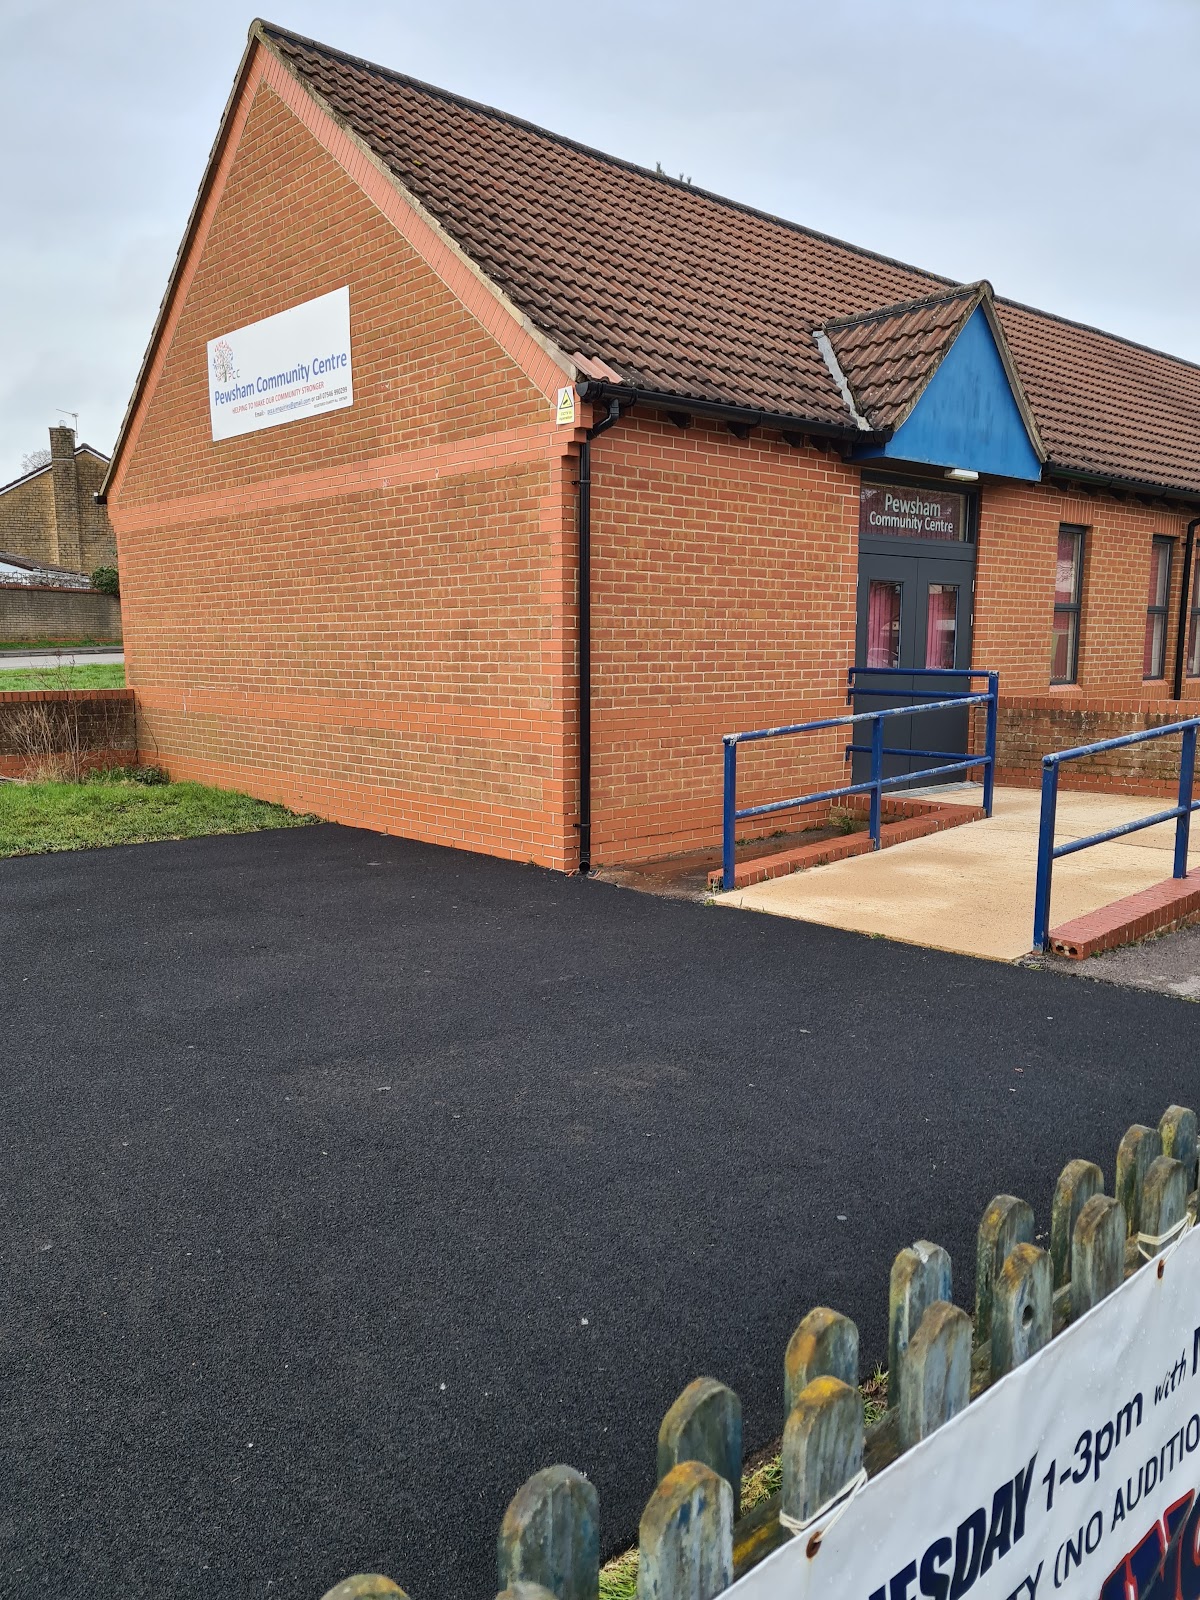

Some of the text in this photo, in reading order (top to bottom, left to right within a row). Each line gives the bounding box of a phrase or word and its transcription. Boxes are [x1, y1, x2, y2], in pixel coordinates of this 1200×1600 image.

[214, 353, 347, 406] Pewsham Community Centre
[232, 403, 248, 414] HELPING
[248, 402, 254, 410] TO
[254, 398, 265, 408] MAKE
[265, 396, 275, 404] OUR
[275, 388, 301, 402] COMMUNITY
[301, 381, 325, 395] STRONGER
[869, 511, 954, 533] Community Centre
[885, 493, 941, 517] Pewsham
[1042, 1392, 1143, 1512] 1-3pm
[1154, 1348, 1187, 1407] with
[1054, 1511, 1103, 1589] (NO
